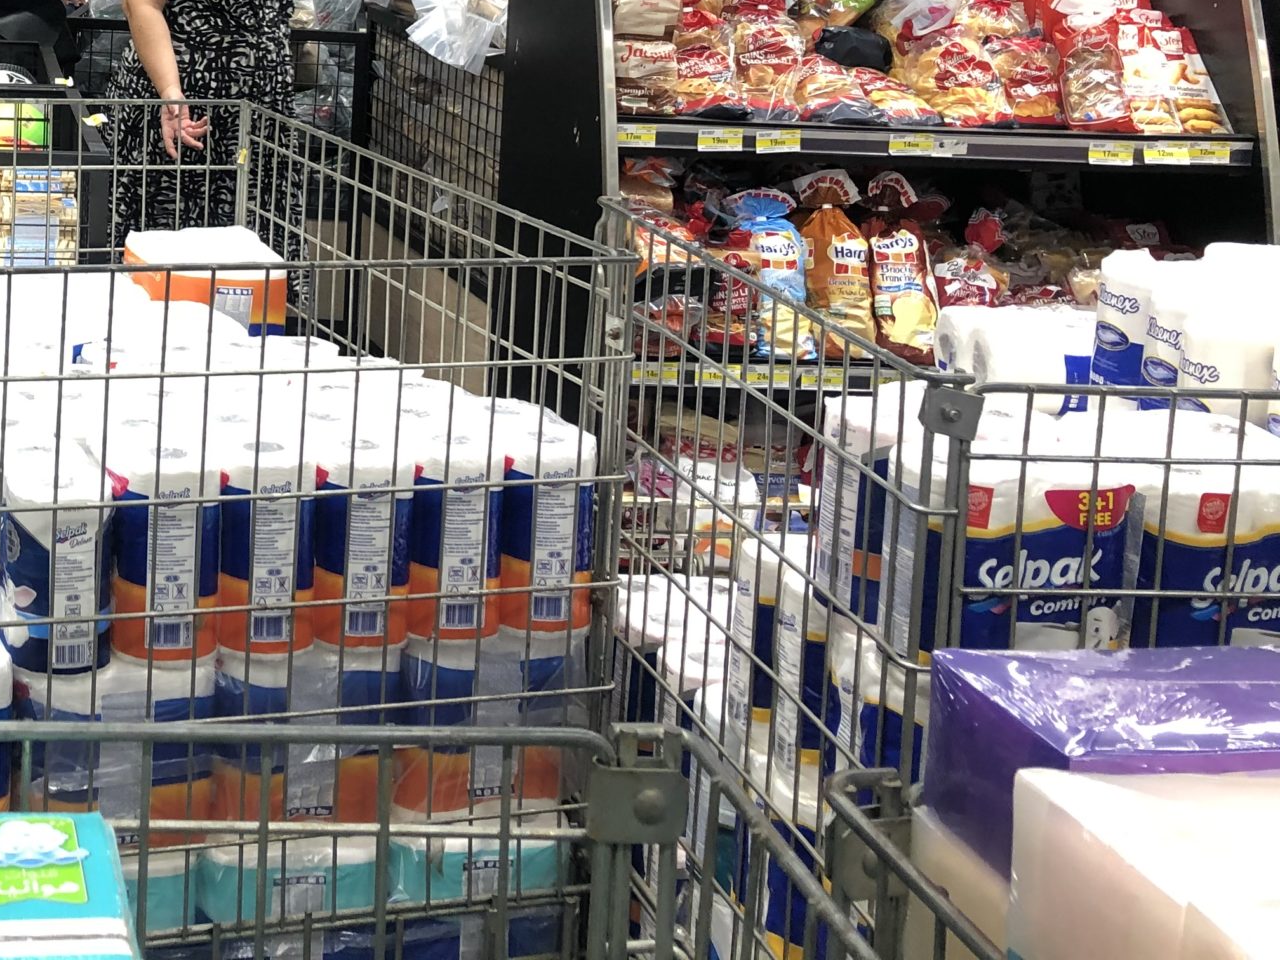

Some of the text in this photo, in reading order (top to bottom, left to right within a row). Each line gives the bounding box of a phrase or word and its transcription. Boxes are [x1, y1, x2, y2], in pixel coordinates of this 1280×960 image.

[1134, 228, 1157, 241] Ster
[56, 522, 87, 541] Selpak
[978, 548, 1102, 601] Selpak
